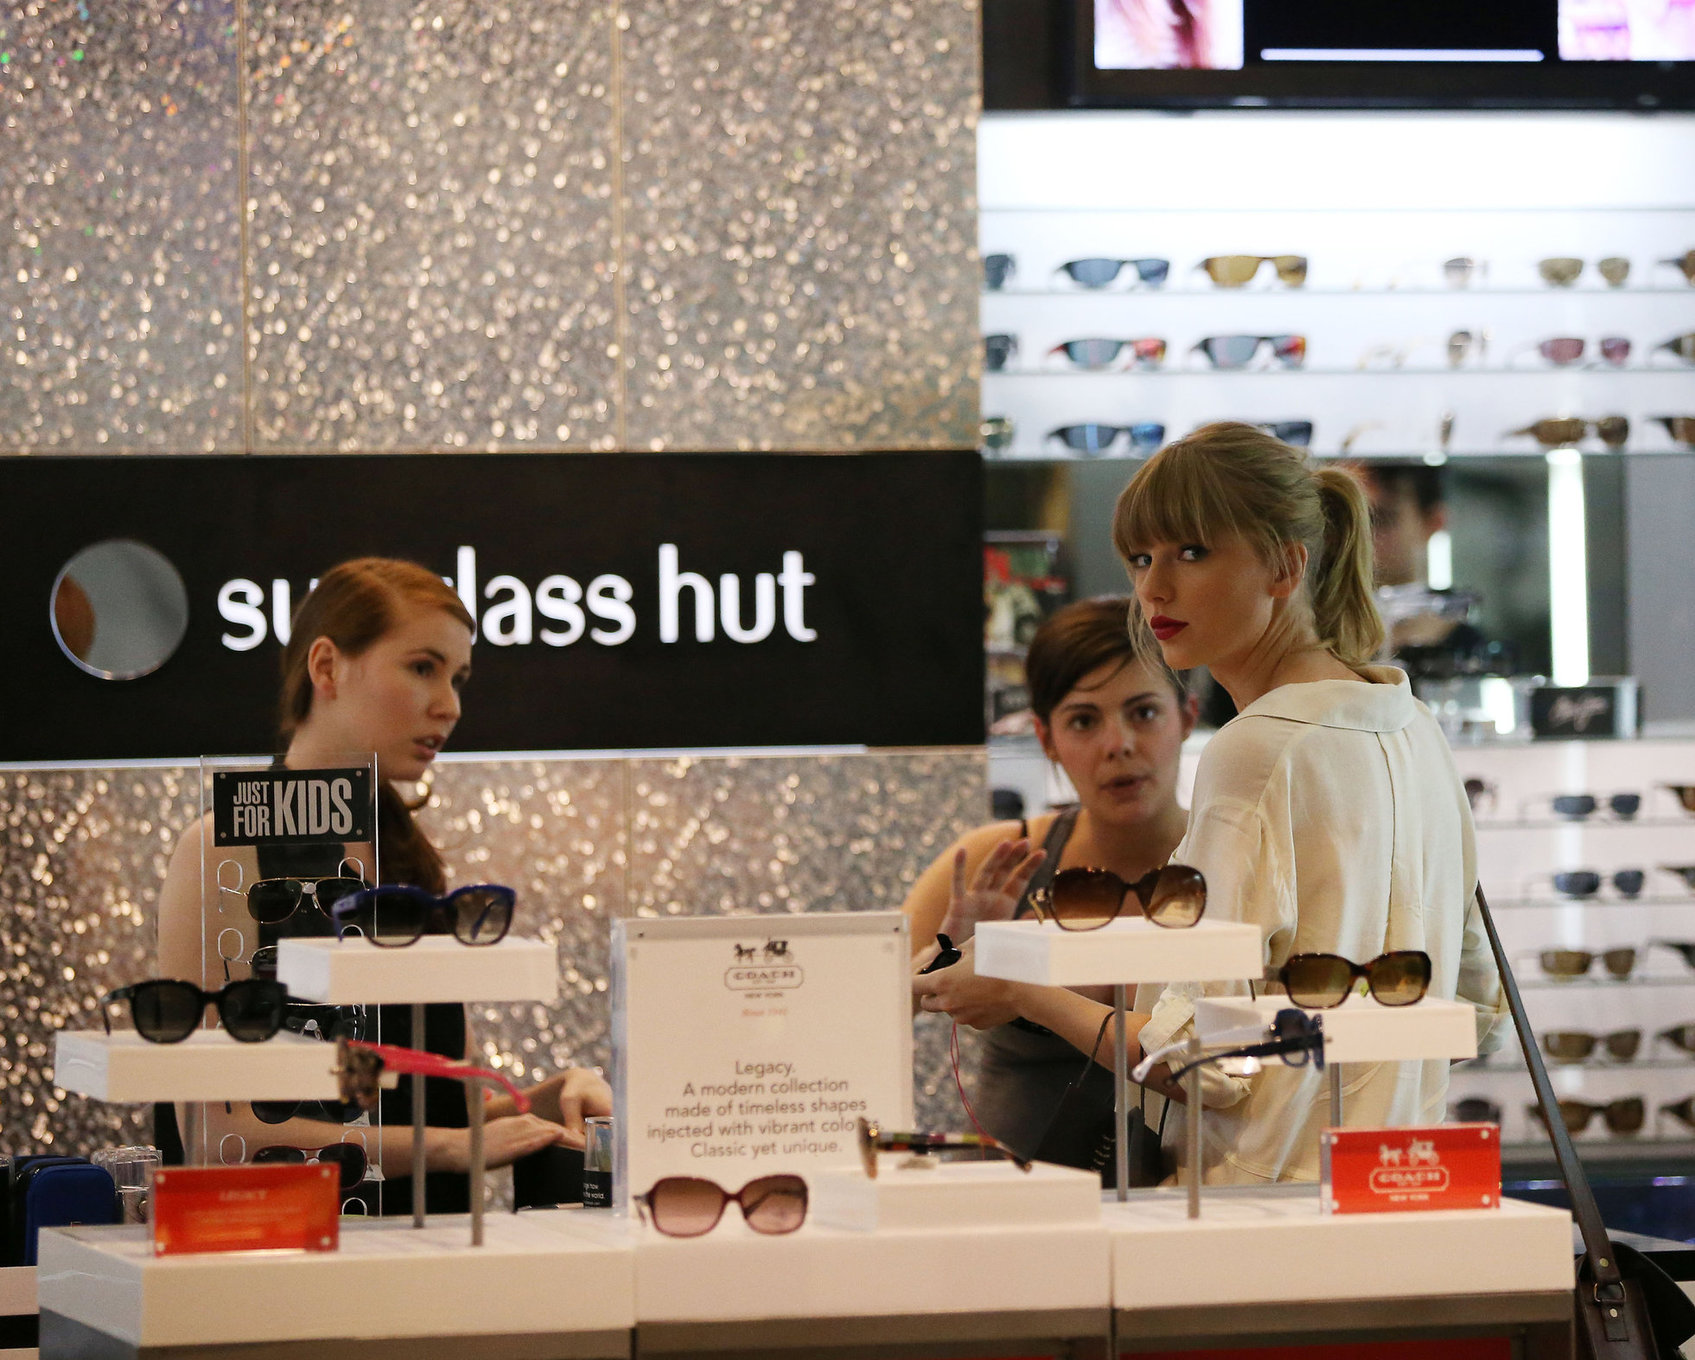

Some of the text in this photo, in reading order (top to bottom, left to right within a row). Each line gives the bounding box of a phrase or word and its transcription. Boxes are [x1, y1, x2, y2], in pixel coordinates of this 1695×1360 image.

[658, 542, 818, 644] hut
[233, 781, 270, 805] JUST
[273, 777, 353, 837] KIDS
[233, 805, 271, 838] FOR
[733, 970, 795, 980] COACH
[735, 1060, 796, 1079] Legacy.
[683, 1077, 849, 1097] A modern collection
[665, 1097, 867, 1118] made of timeless shapes
[647, 1121, 713, 1143] injected
[719, 1119, 753, 1136] with
[759, 1118, 815, 1135] vibrant
[690, 1139, 843, 1160] Classic yet unique.
[1378, 1171, 1440, 1183] COACH
